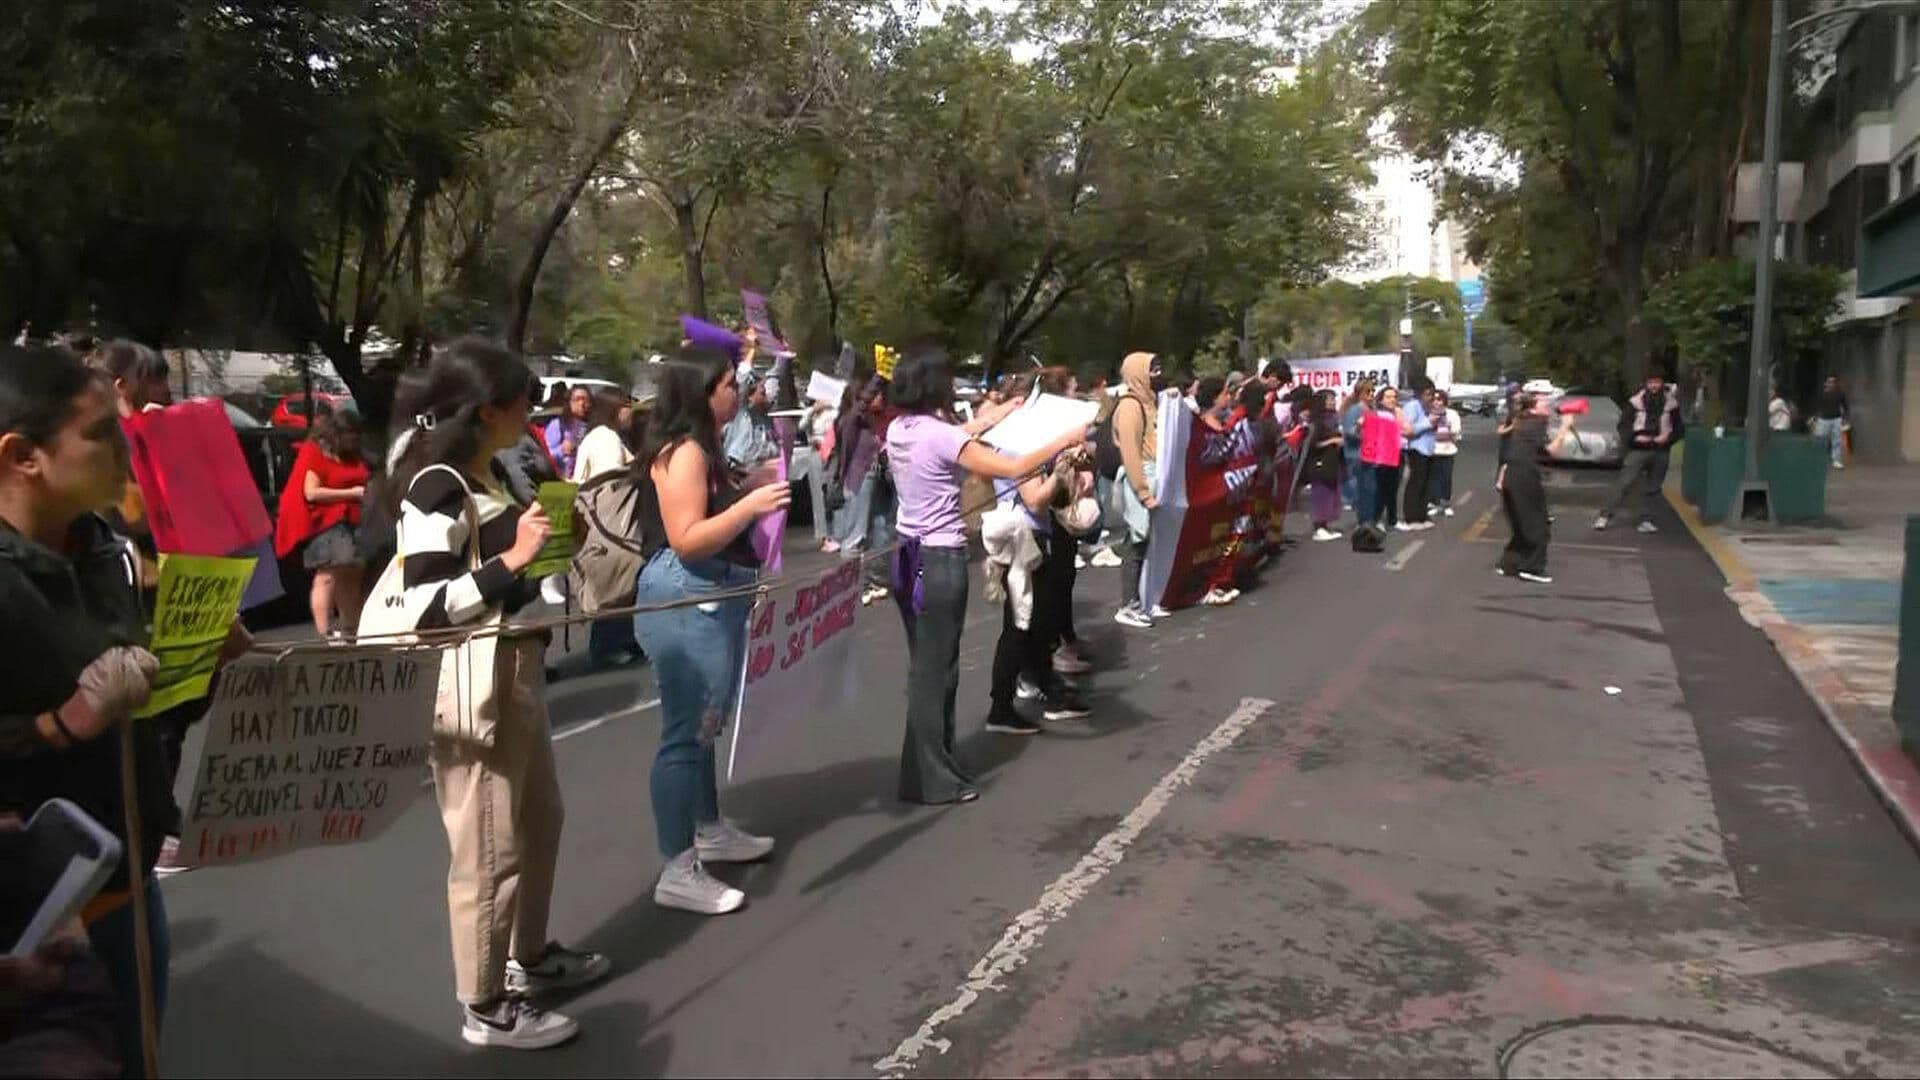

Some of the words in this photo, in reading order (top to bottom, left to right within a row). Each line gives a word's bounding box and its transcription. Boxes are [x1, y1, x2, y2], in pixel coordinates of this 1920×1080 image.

[1286, 367, 1342, 389] TICIA
[319, 657, 385, 695] TRATA
[230, 709, 277, 745] HAY
[206, 750, 278, 786] FUERA
[310, 744, 366, 775] JUEZ
